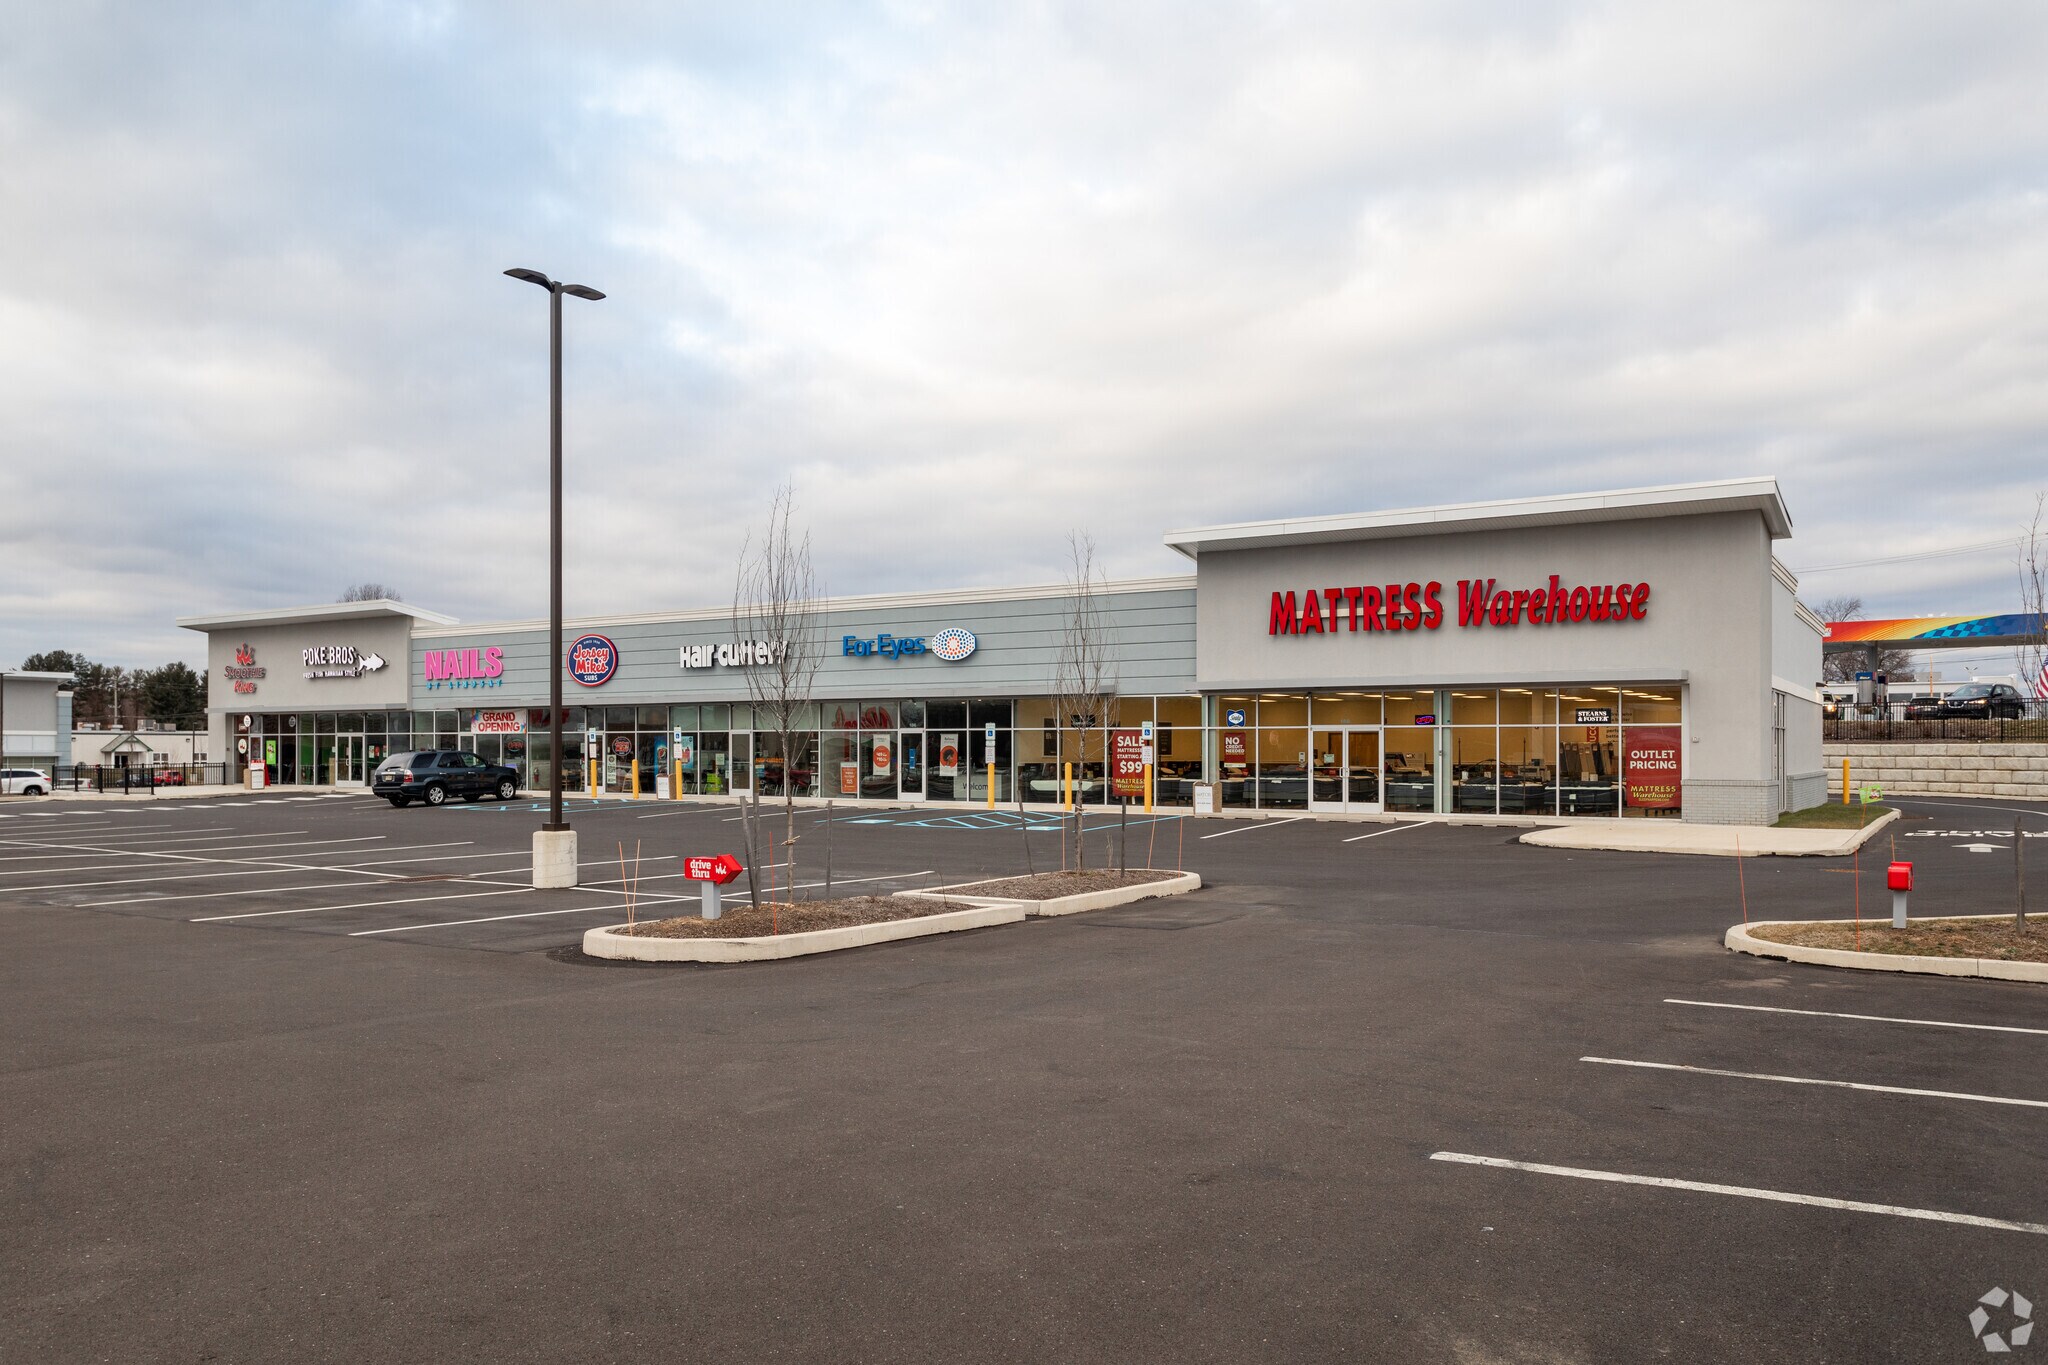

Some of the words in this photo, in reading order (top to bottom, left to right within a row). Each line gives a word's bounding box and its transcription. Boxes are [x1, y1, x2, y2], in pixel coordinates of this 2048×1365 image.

[1269, 581, 1444, 635] MATTRESS
[1457, 575, 1650, 626] Warehouse
[843, 635, 875, 656] For
[878, 634, 925, 660] Eyes
[302, 647, 327, 666] POKE
[329, 646, 355, 665] BROS
[573, 645, 609, 662] Jersey
[425, 646, 503, 680] NAILS
[575, 659, 608, 674] Mike's
[482, 712, 516, 722] GRAND
[478, 722, 520, 732] OPENING
[1117, 736, 1145, 747] SALE
[1225, 737, 1240, 745] NO
[1631, 750, 1675, 759] OUTLET
[1119, 760, 1143, 774] $99
[1630, 761, 1677, 769] PRICING
[690, 859, 711, 869] drive
[691, 868, 710, 878] thru
